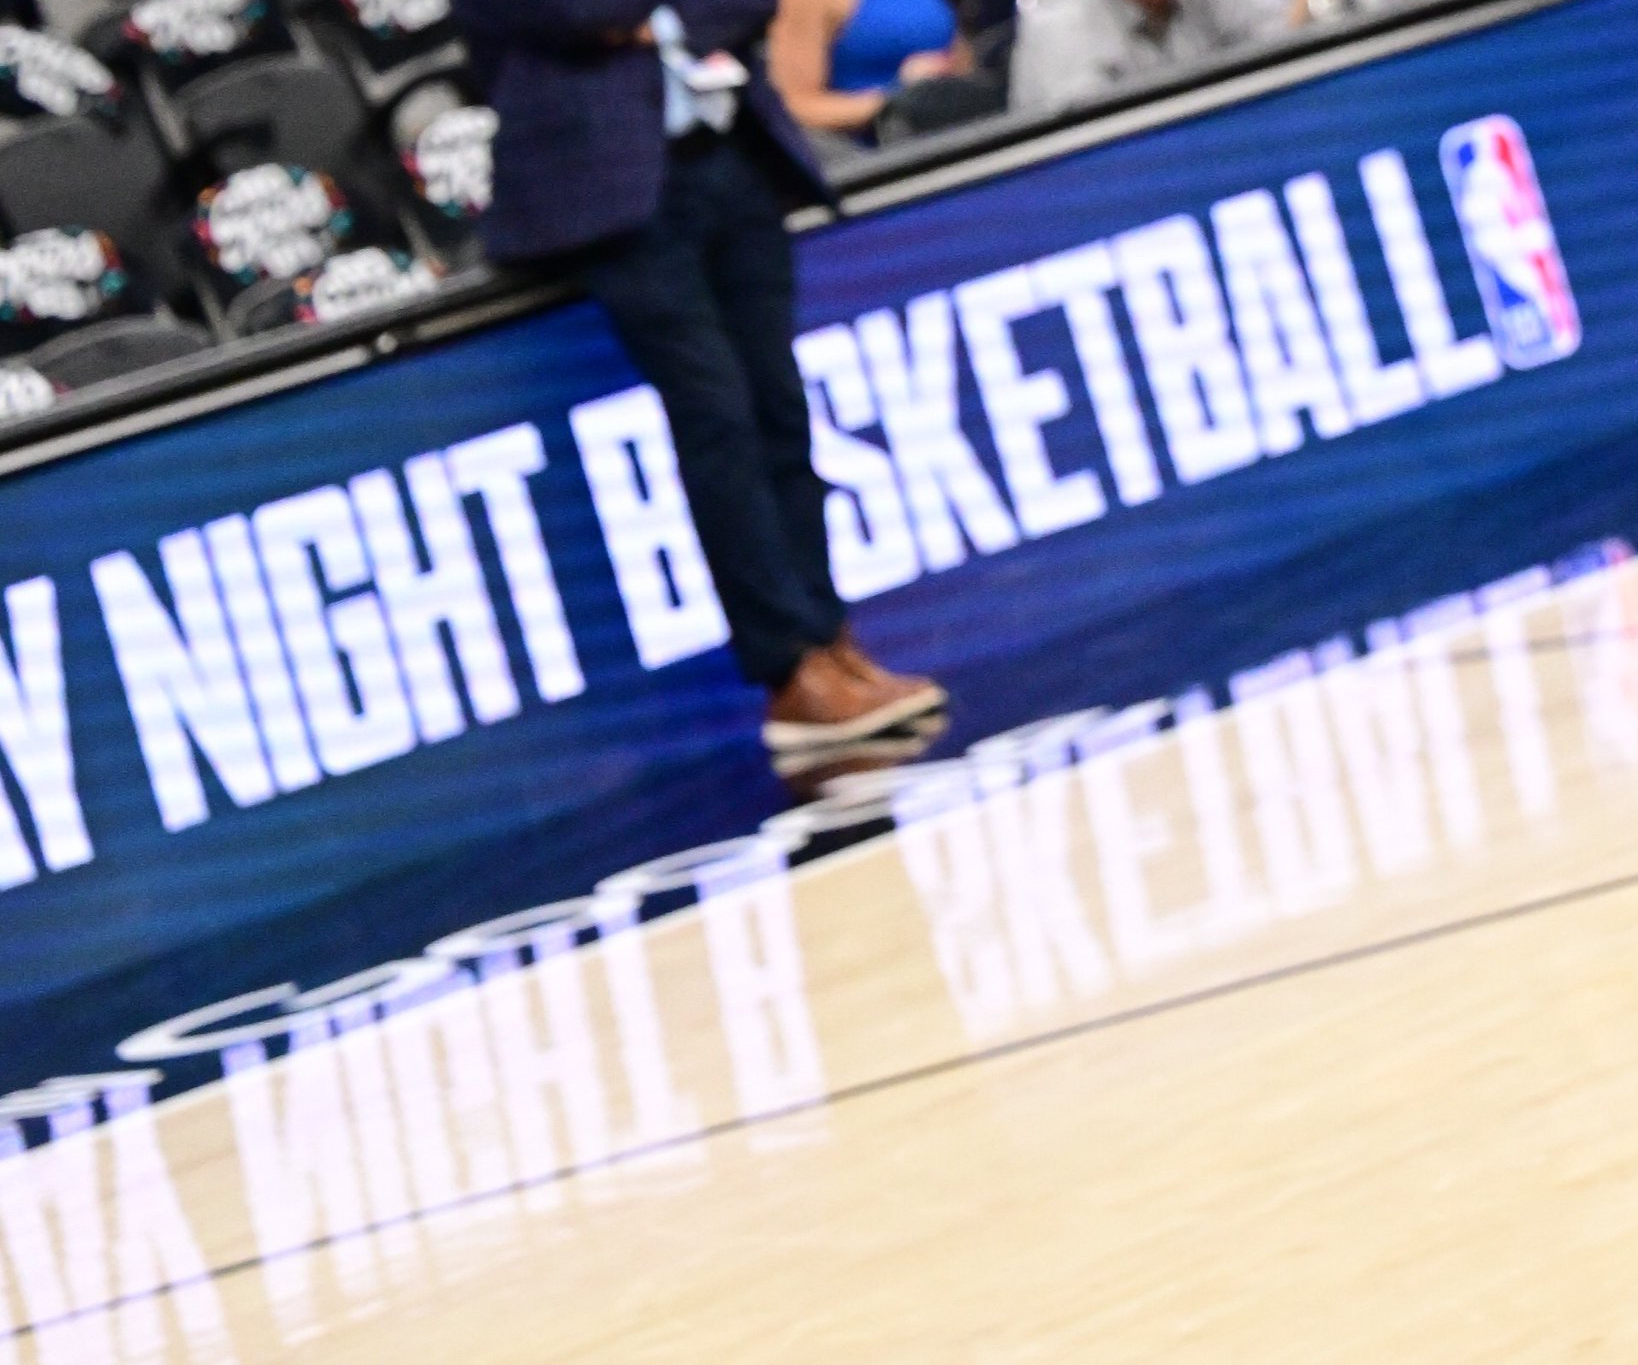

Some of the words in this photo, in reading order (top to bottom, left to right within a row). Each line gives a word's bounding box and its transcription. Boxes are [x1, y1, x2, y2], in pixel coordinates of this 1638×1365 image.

[0, 575, 96, 892] Y
[89, 422, 587, 834] NIGHT
[568, 147, 1505, 671] BSKETBALL
